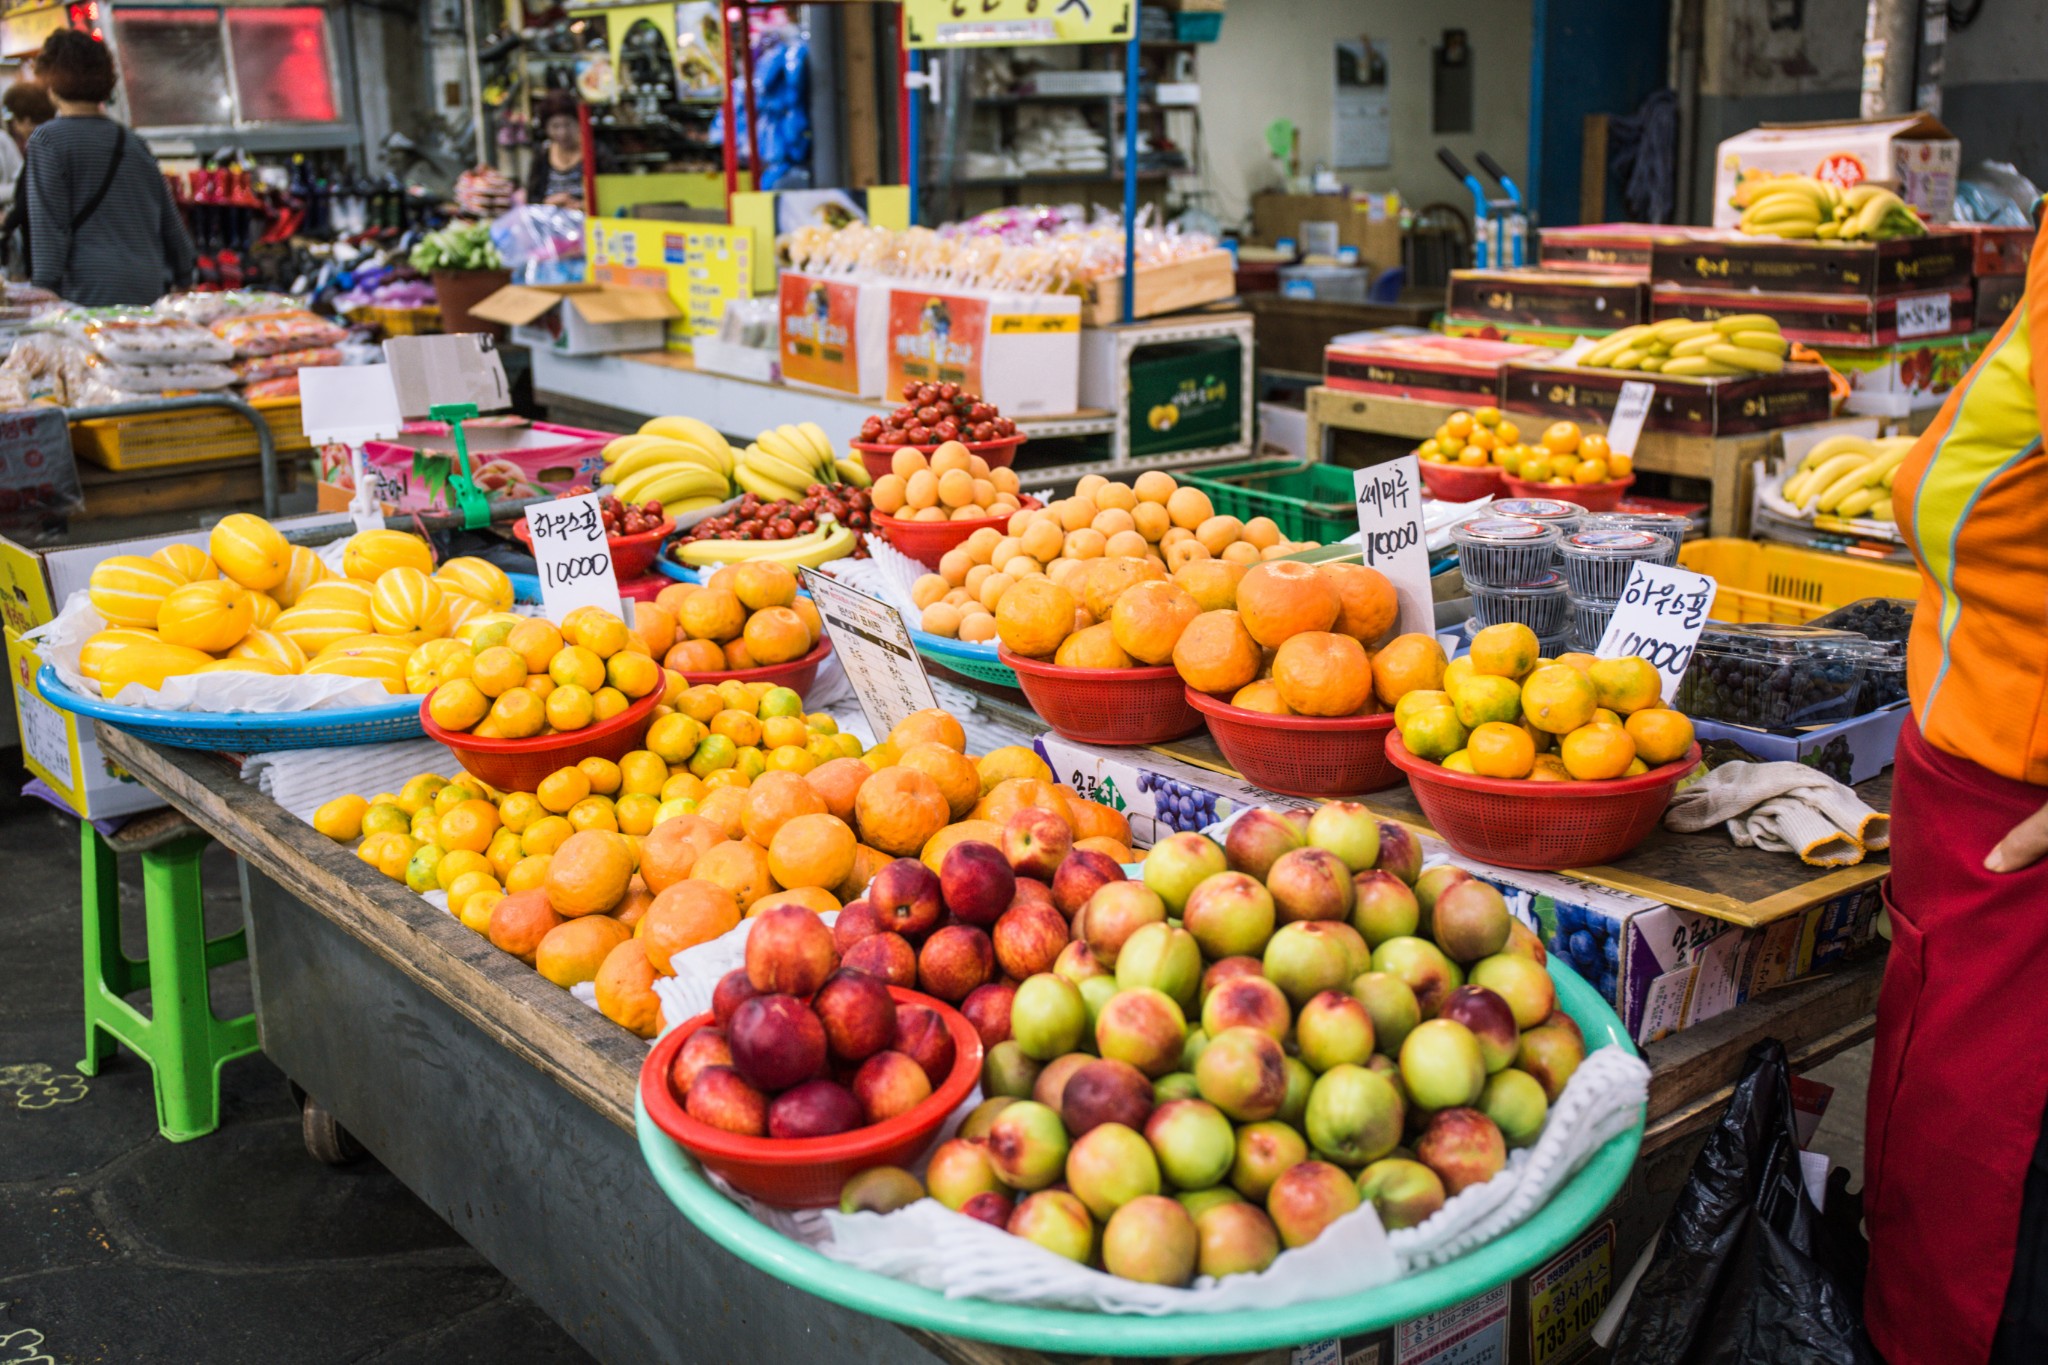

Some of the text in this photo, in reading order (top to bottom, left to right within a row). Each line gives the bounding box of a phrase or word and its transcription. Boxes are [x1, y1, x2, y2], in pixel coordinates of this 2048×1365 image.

[534, 500, 603, 541] 하우스귤
[1625, 569, 1711, 629] 하우스귤
[1533, 1278, 1546, 1297] LPG
[1553, 1263, 1609, 1315] 천사가스
[1537, 1284, 1610, 1361] 733-1004
